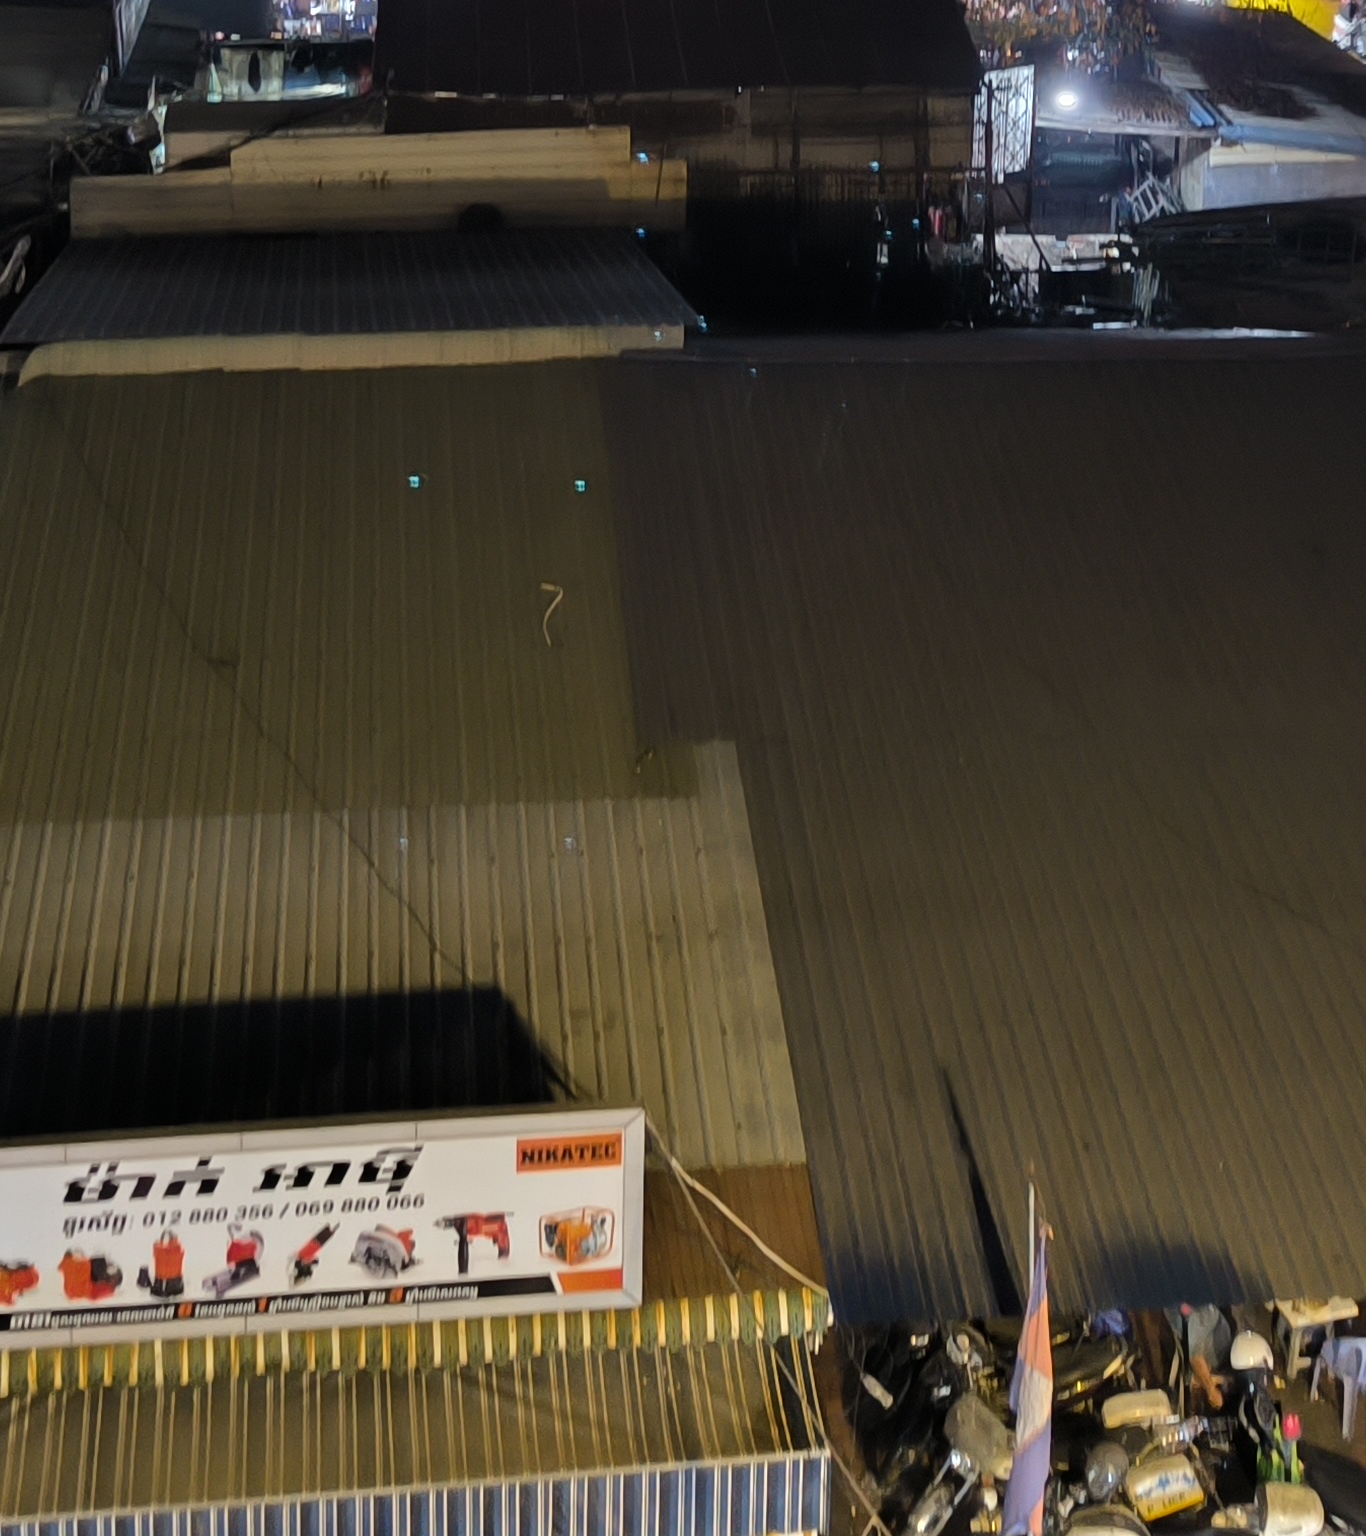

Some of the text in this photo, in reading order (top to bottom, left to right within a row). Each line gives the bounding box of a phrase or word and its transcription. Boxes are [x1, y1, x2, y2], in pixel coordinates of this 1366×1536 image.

[522, 1142, 616, 1164] NIKATEC
[142, 1210, 182, 1229] 012
[295, 1199, 334, 1217] 069
[387, 1194, 424, 1210] 066
